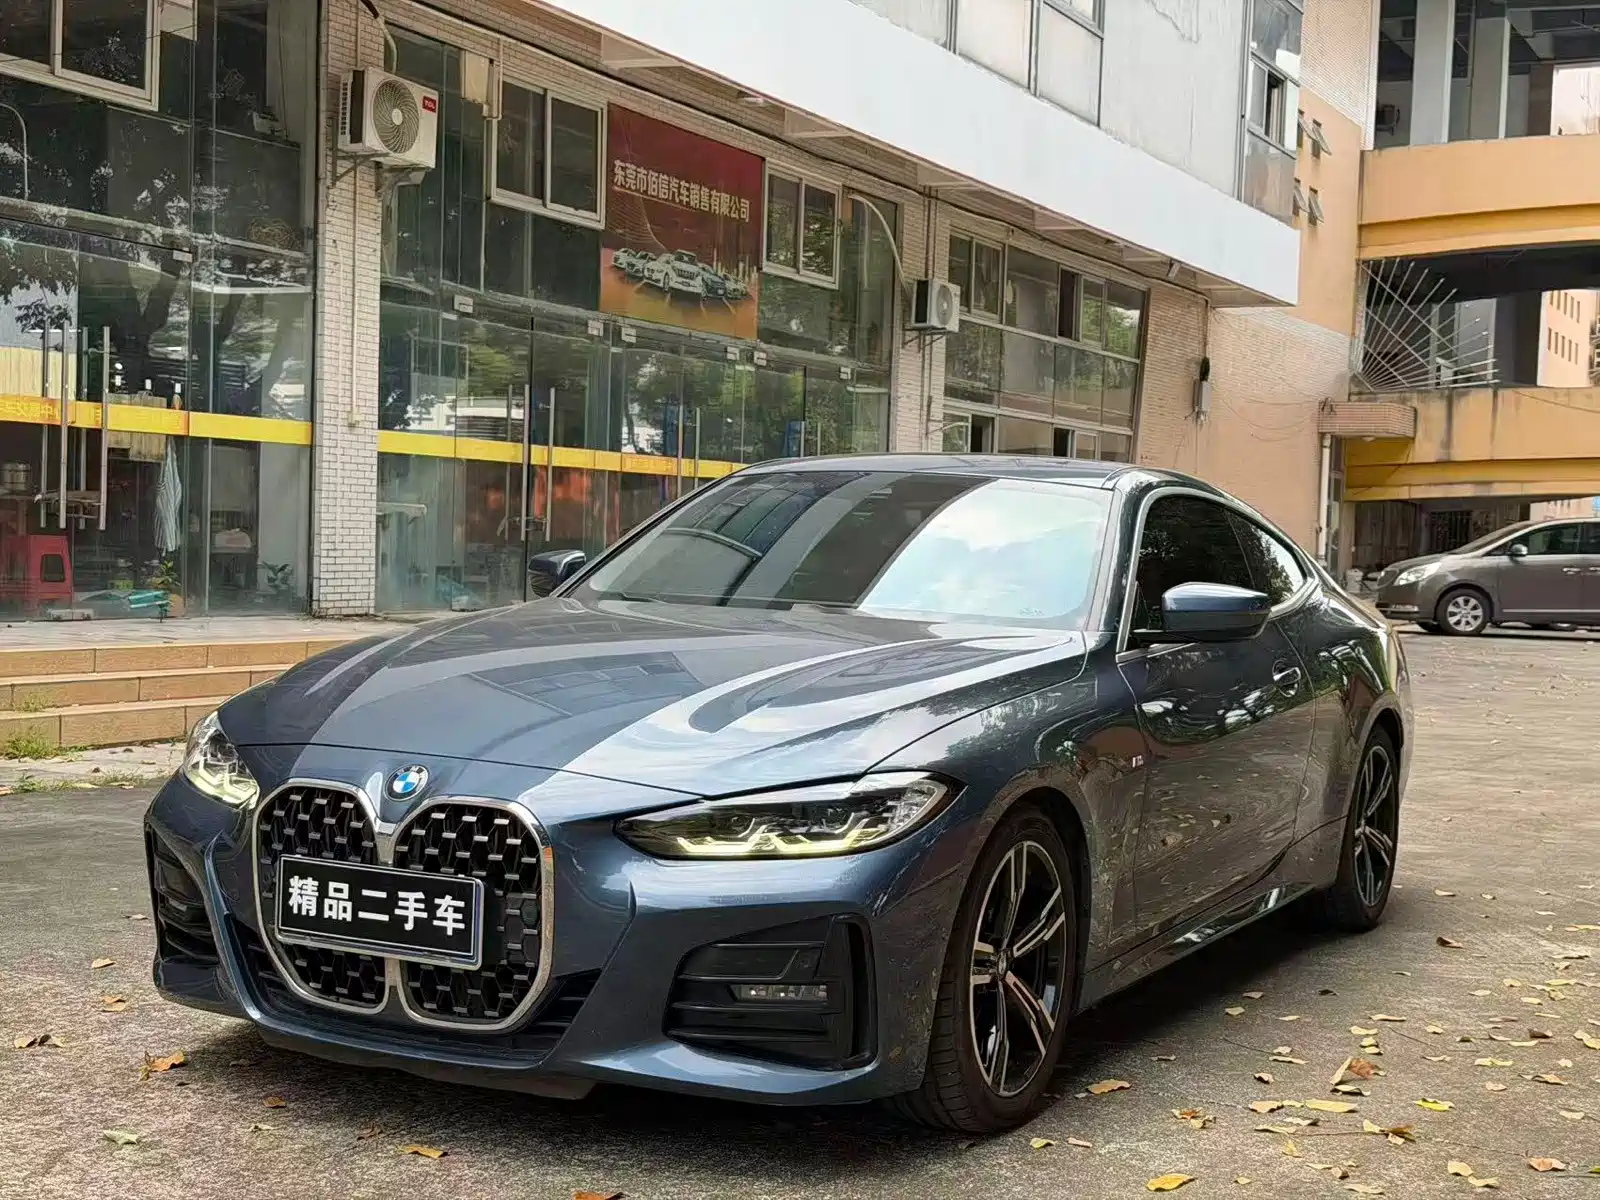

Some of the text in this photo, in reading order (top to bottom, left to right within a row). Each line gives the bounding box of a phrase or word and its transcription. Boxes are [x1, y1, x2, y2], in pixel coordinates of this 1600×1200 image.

[613, 159, 750, 223] 东莞市佰信汽车销售有限公司
[288, 875, 466, 936] 精品二手车
